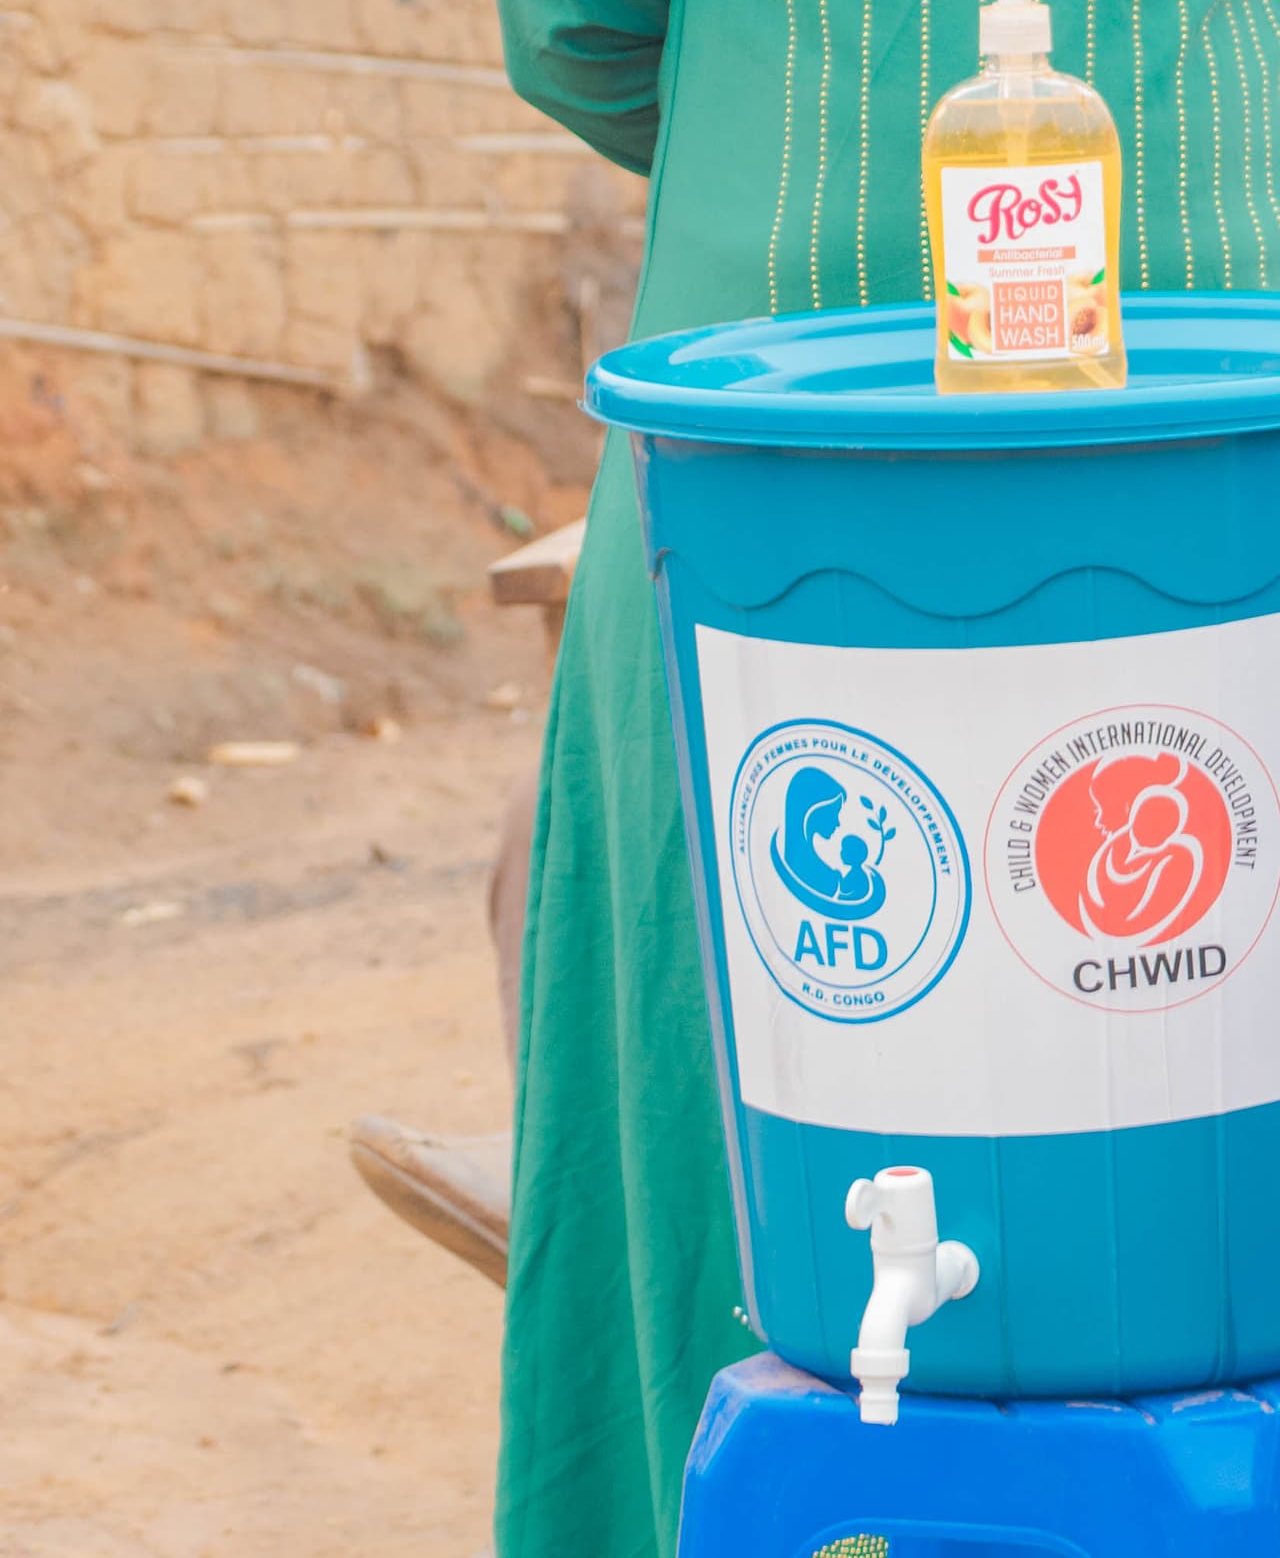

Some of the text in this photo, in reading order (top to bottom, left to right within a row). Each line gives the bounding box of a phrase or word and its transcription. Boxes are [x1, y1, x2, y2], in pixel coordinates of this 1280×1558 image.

[992, 249, 1064, 262] Antibacterial
[989, 266, 1034, 279] Summer
[1000, 286, 1059, 303] LIQUID
[1000, 304, 1059, 323] HAND
[1000, 327, 1061, 348] WASH
[750, 762, 764, 784] DES
[764, 738, 809, 764] FEMMES
[812, 738, 848, 754] POUR
[851, 749, 869, 762] LE
[873, 759, 951, 875] DÉVELOPPEMENT
[1007, 721, 1258, 893] CHILD & WOMEN INTERNATIONAL DEVELOPMENT
[794, 919, 888, 971] AFD
[1073, 944, 1227, 993] CHWID
[801, 982, 885, 1006] R.D. CONGO
